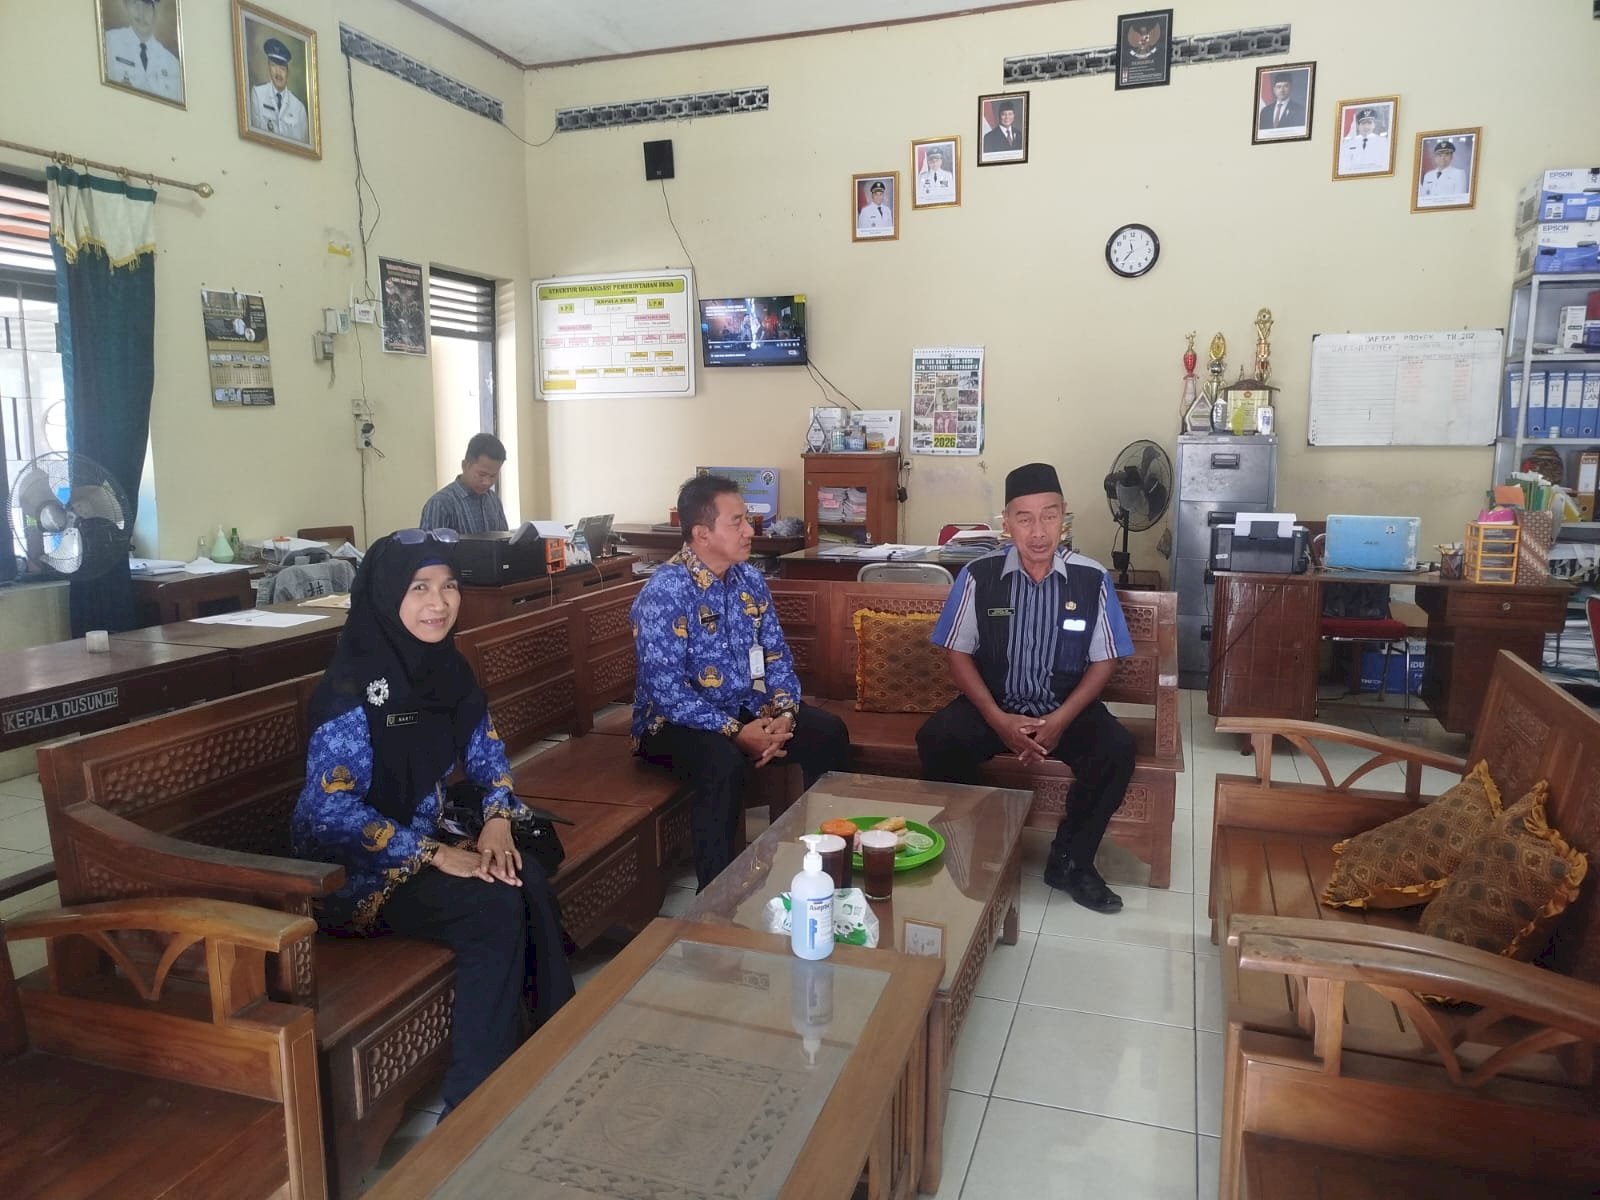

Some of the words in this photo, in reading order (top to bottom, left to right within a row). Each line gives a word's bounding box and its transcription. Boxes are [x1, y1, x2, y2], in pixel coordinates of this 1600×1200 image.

[578, 284, 611, 292] ORGANISASI
[612, 282, 658, 290] PEMERINTAHAN
[934, 437, 956, 447] 2026
[6, 705, 59, 731] KEPALA
[62, 694, 103, 717] DUSUN
